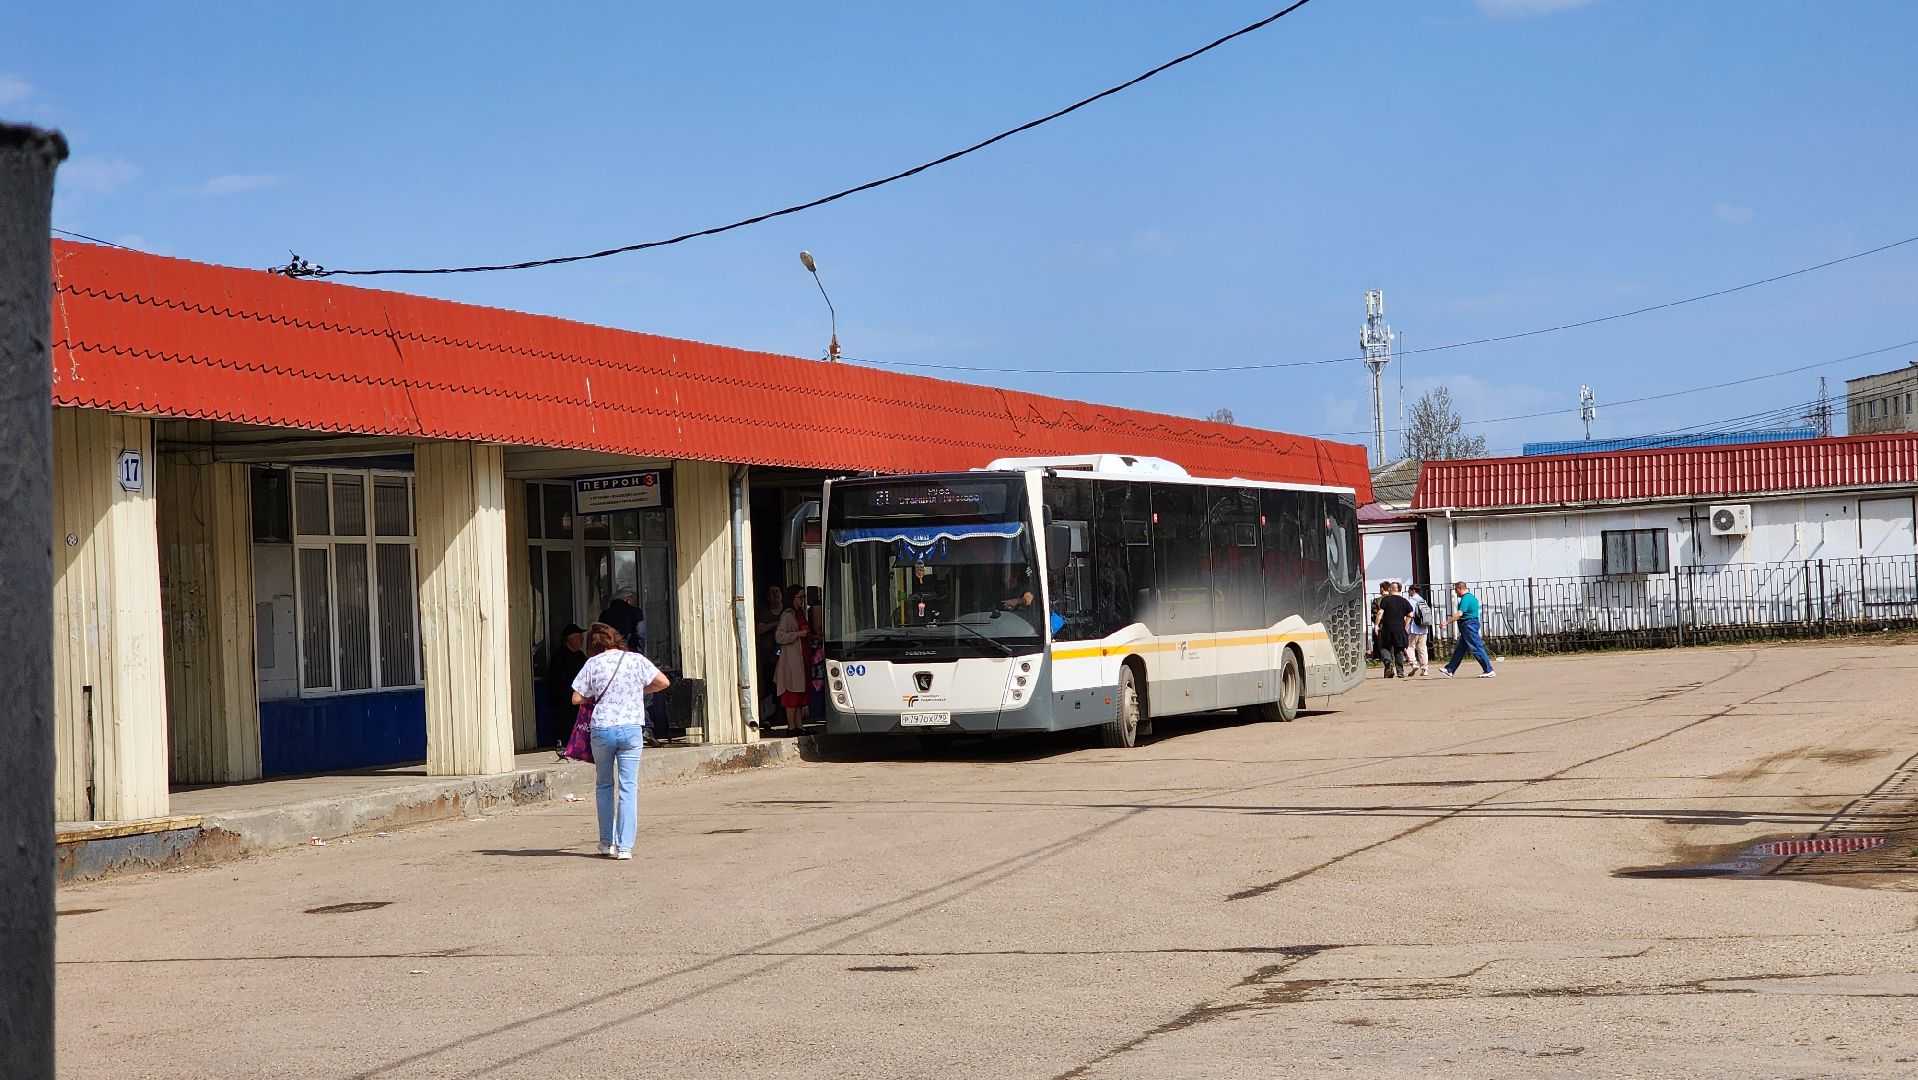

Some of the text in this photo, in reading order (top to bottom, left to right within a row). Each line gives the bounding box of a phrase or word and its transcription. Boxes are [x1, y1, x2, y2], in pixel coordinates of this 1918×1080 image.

[124, 458, 140, 482] 17
[583, 474, 654, 490] ПЕРРОН 3
